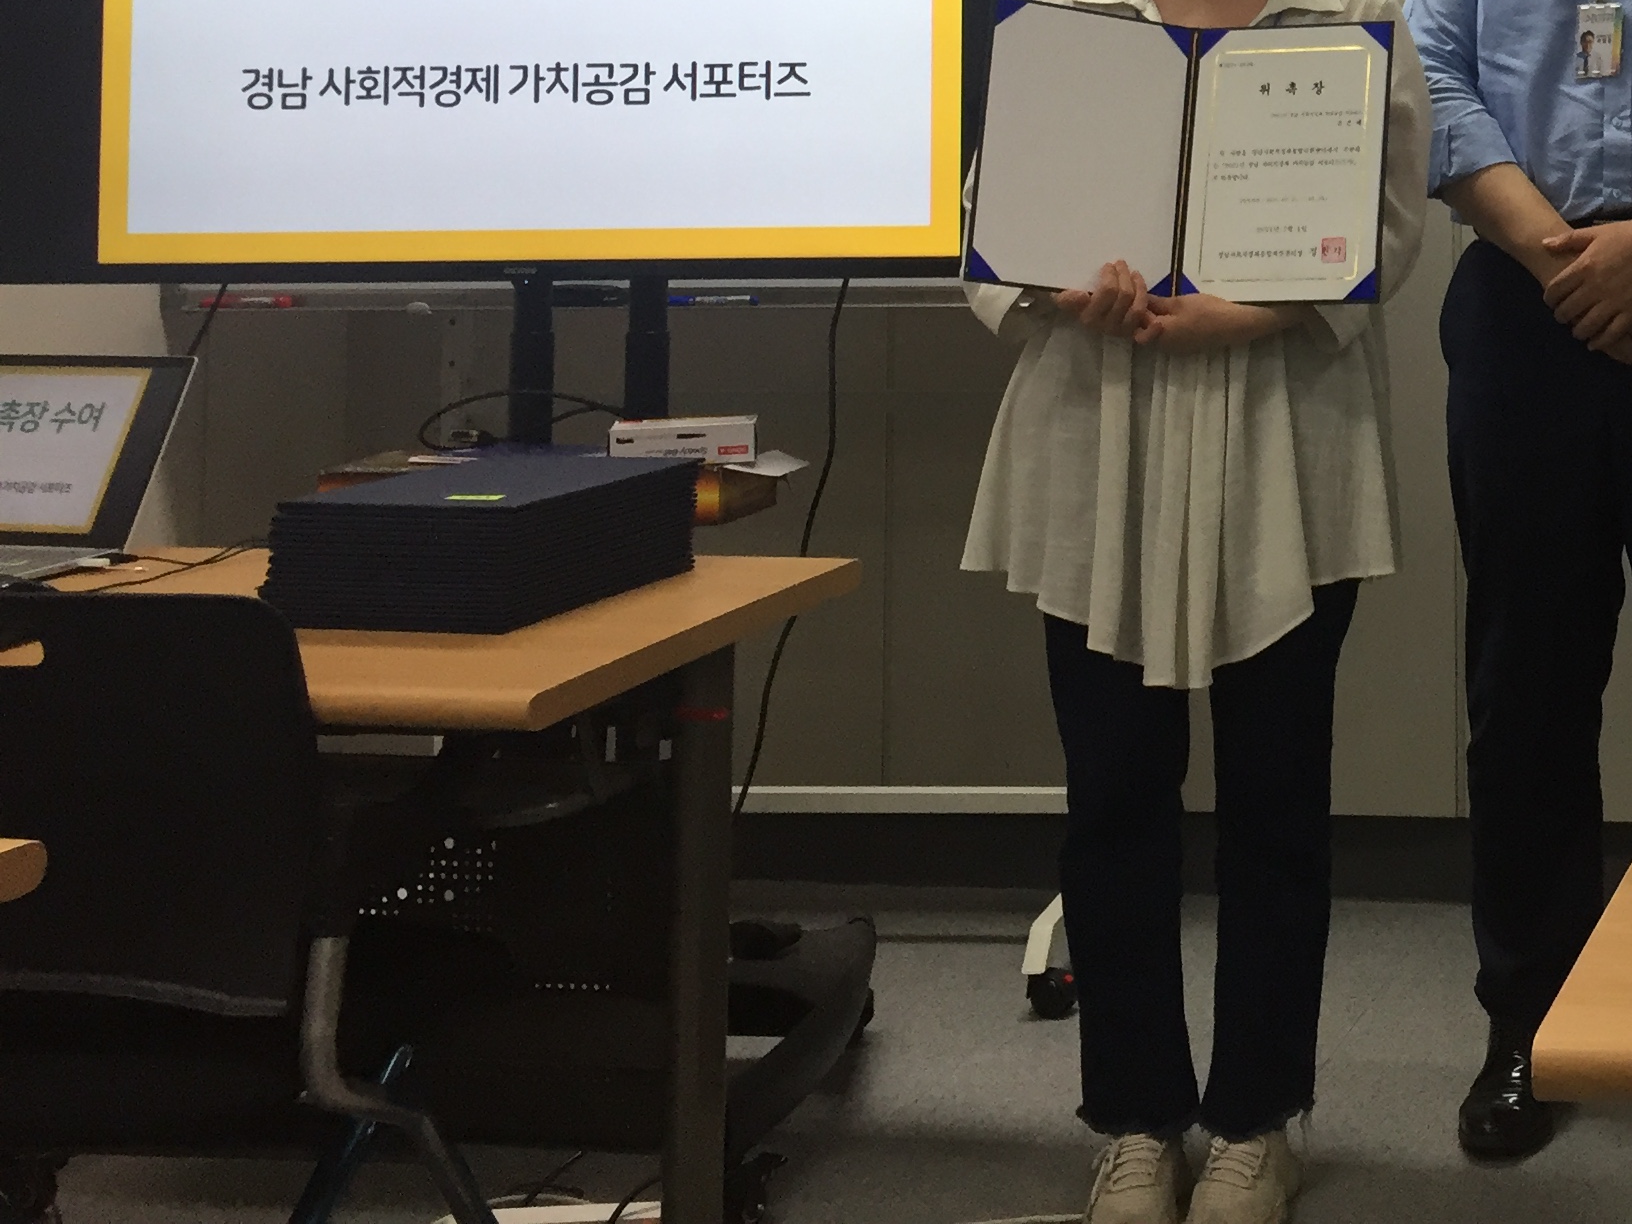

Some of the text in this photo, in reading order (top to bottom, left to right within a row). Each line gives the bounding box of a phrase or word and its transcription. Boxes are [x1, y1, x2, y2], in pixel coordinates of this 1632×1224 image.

[240, 59, 812, 111] 경남 사회적경제 가치공감 서포터즈
[50, 401, 106, 434] 수여
